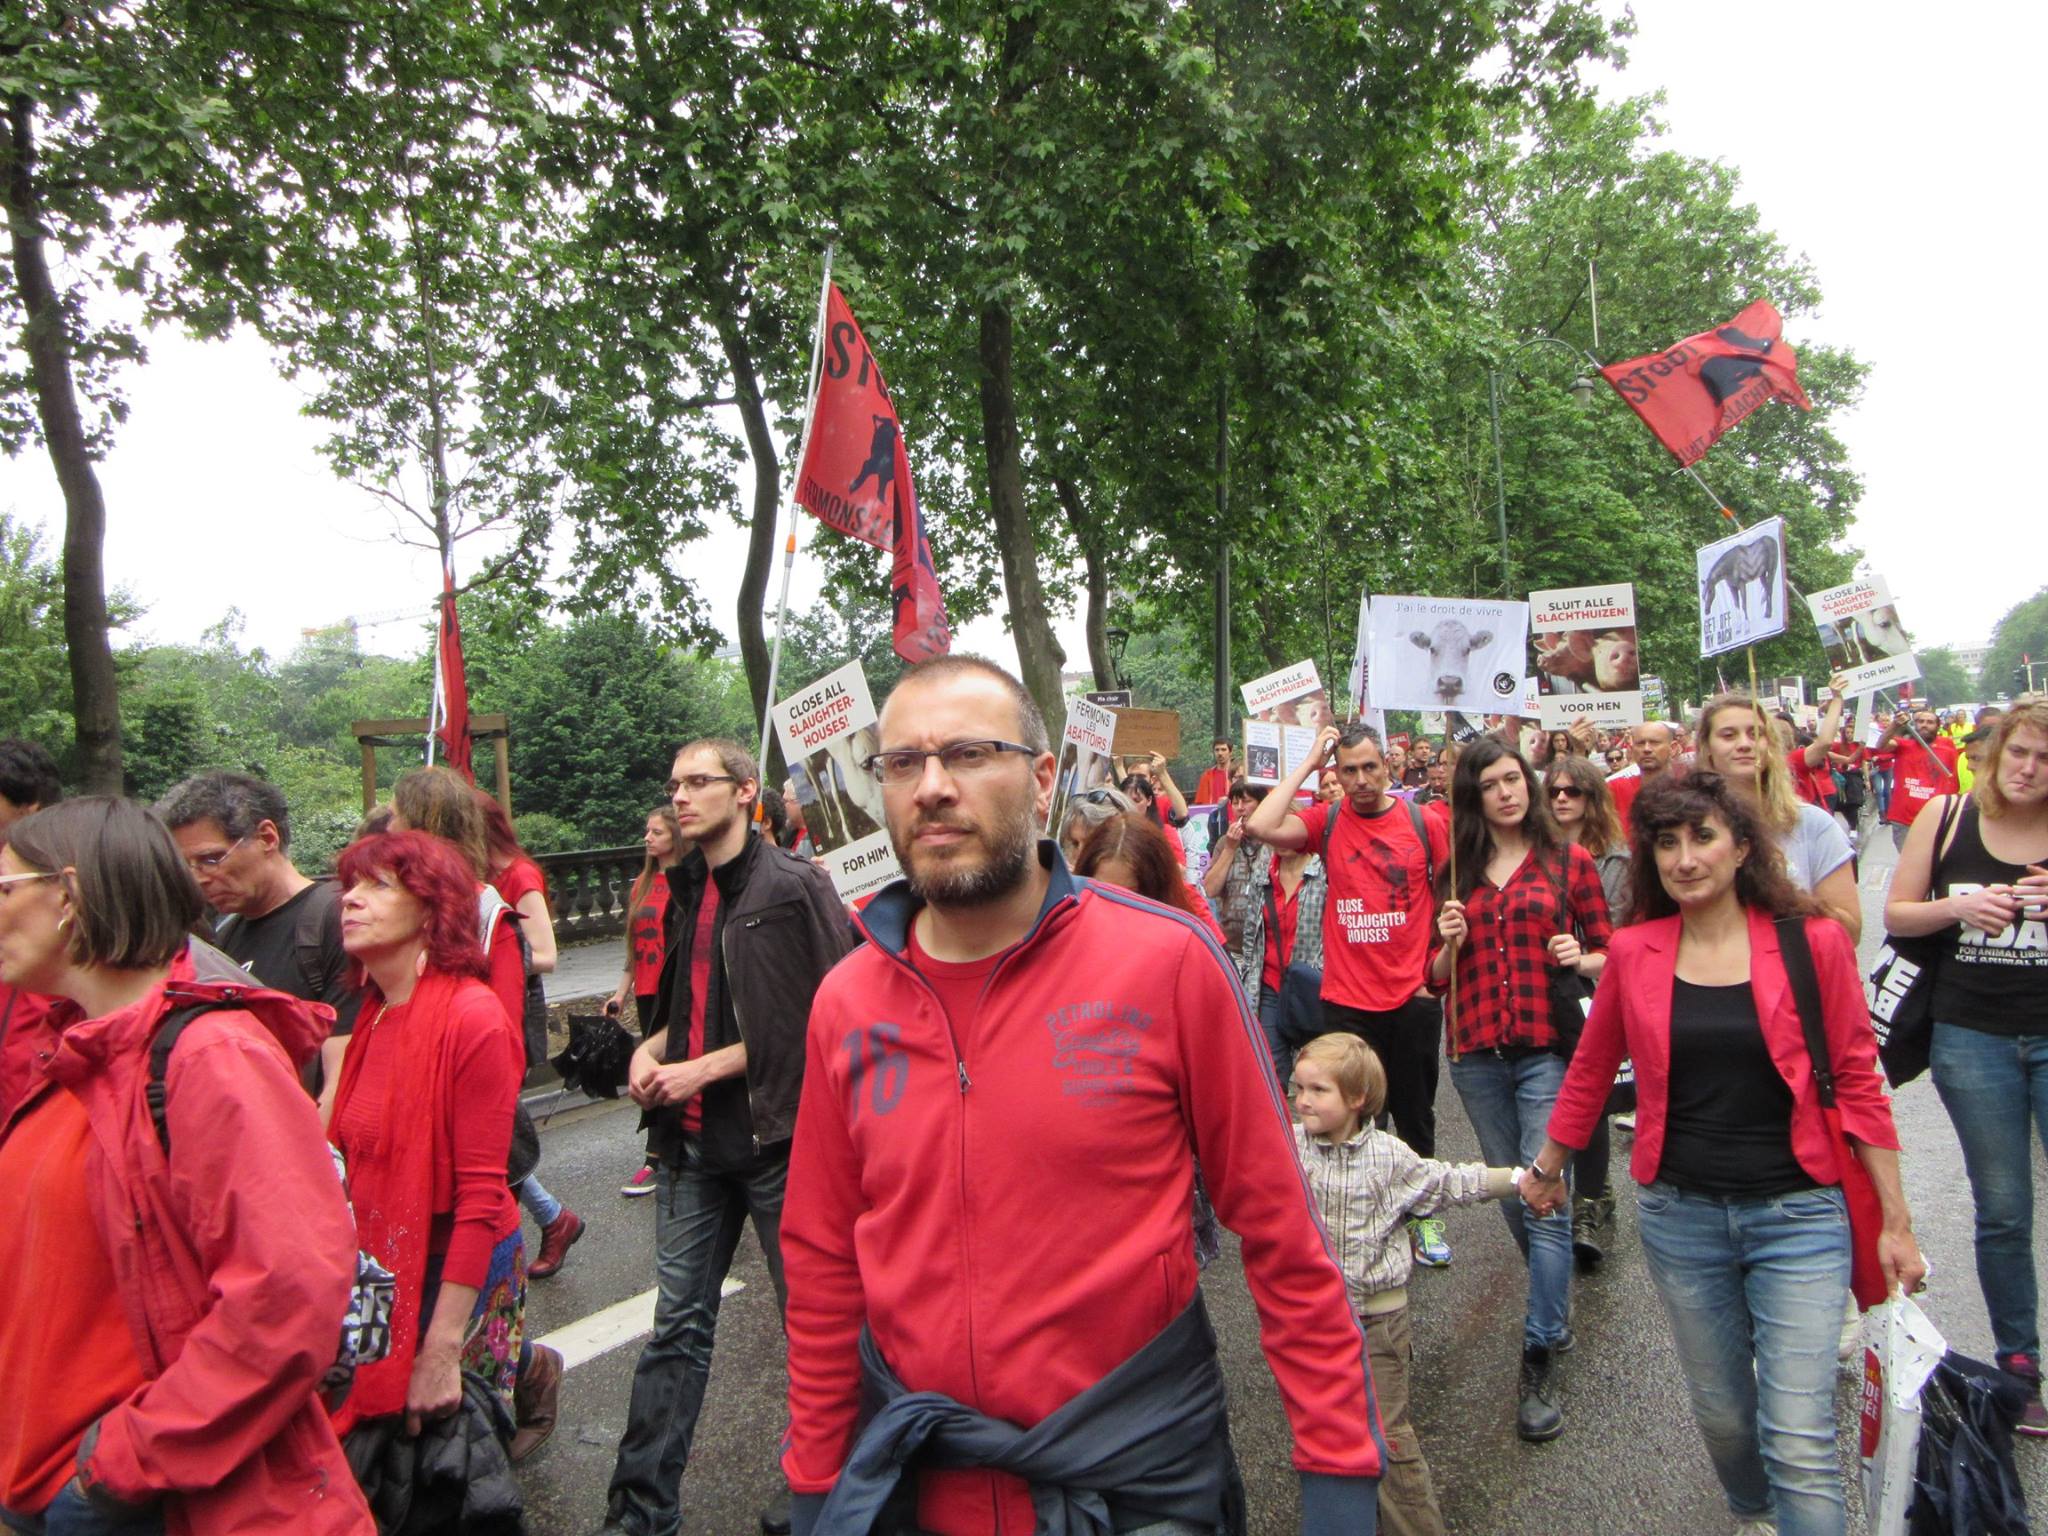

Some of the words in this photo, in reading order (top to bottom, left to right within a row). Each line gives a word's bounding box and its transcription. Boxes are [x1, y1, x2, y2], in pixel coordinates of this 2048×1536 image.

[1823, 588, 1853, 602] CLOSE
[1855, 583, 1872, 593] ALL
[1417, 603, 1426, 613] le
[1430, 604, 1456, 615] droit
[1459, 606, 1472, 615] de
[1477, 607, 1503, 617] vivre
[1548, 600, 1581, 611] SLUIT
[1584, 597, 1614, 608] ALLE
[1536, 607, 1629, 623] SLACHTHUIZEN!
[1857, 670, 1877, 681] FOR
[1879, 664, 1896, 675] HIM
[1256, 681, 1280, 696] SLUIT
[1281, 672, 1304, 687] ALLE
[789, 691, 823, 720] CLOSE
[825, 681, 846, 702] ALL
[1560, 702, 1594, 713] VOOR
[1597, 701, 1621, 711] HEN
[789, 695, 856, 739] SLAUGHTER-
[1075, 700, 1111, 728] FERMONS
[803, 714, 850, 749] HOUSES!
[1085, 719, 1097, 732] LES
[1067, 724, 1107, 752] ABATTOIRS
[842, 855, 867, 875] FOR
[868, 845, 890, 866] HIM
[1336, 898, 1364, 913] CLOSE
[1347, 911, 1406, 928] SLAUGHTER
[1347, 927, 1390, 943] HOUSES
[1978, 948, 2018, 958] ANIMAL
